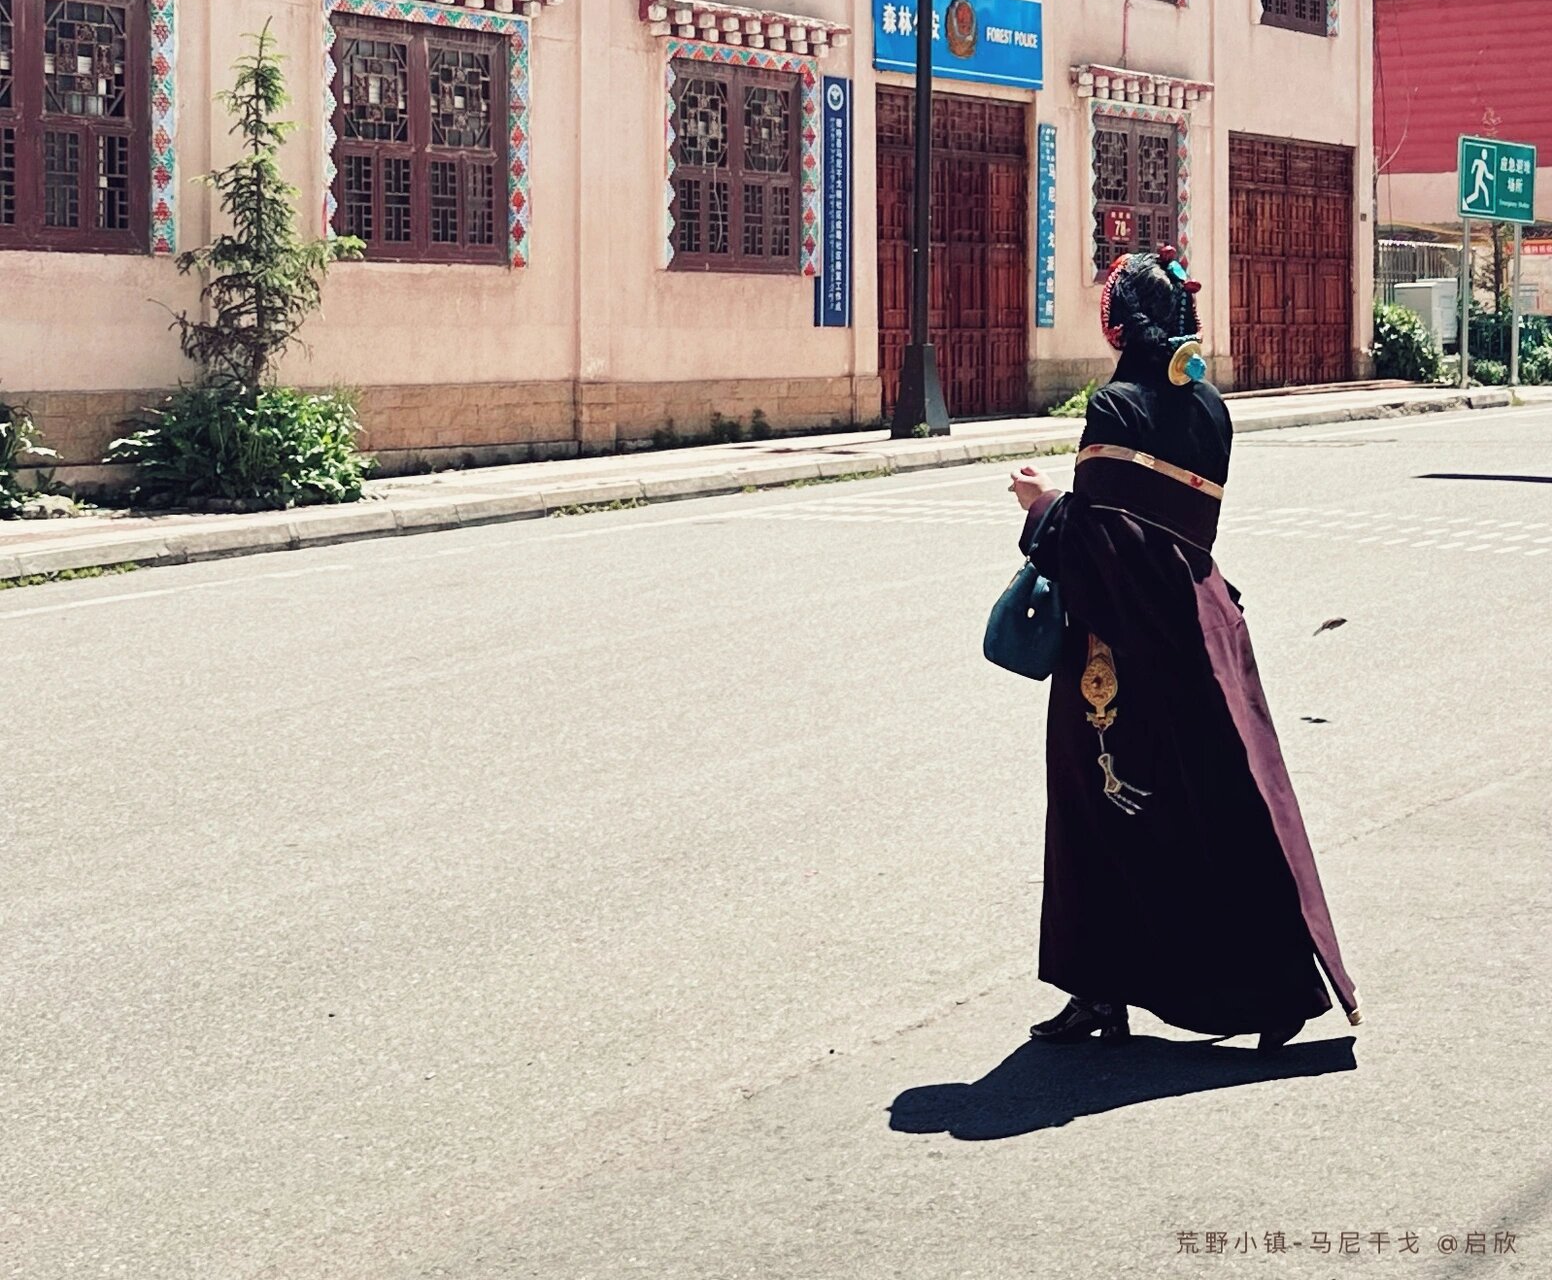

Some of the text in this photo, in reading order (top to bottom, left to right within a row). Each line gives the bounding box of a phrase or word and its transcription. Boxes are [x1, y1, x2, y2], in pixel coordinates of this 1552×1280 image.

[986, 26, 1038, 49] FOREST POLICE
[1500, 156, 1531, 175] 应急避难
[1507, 177, 1523, 194] 场所
